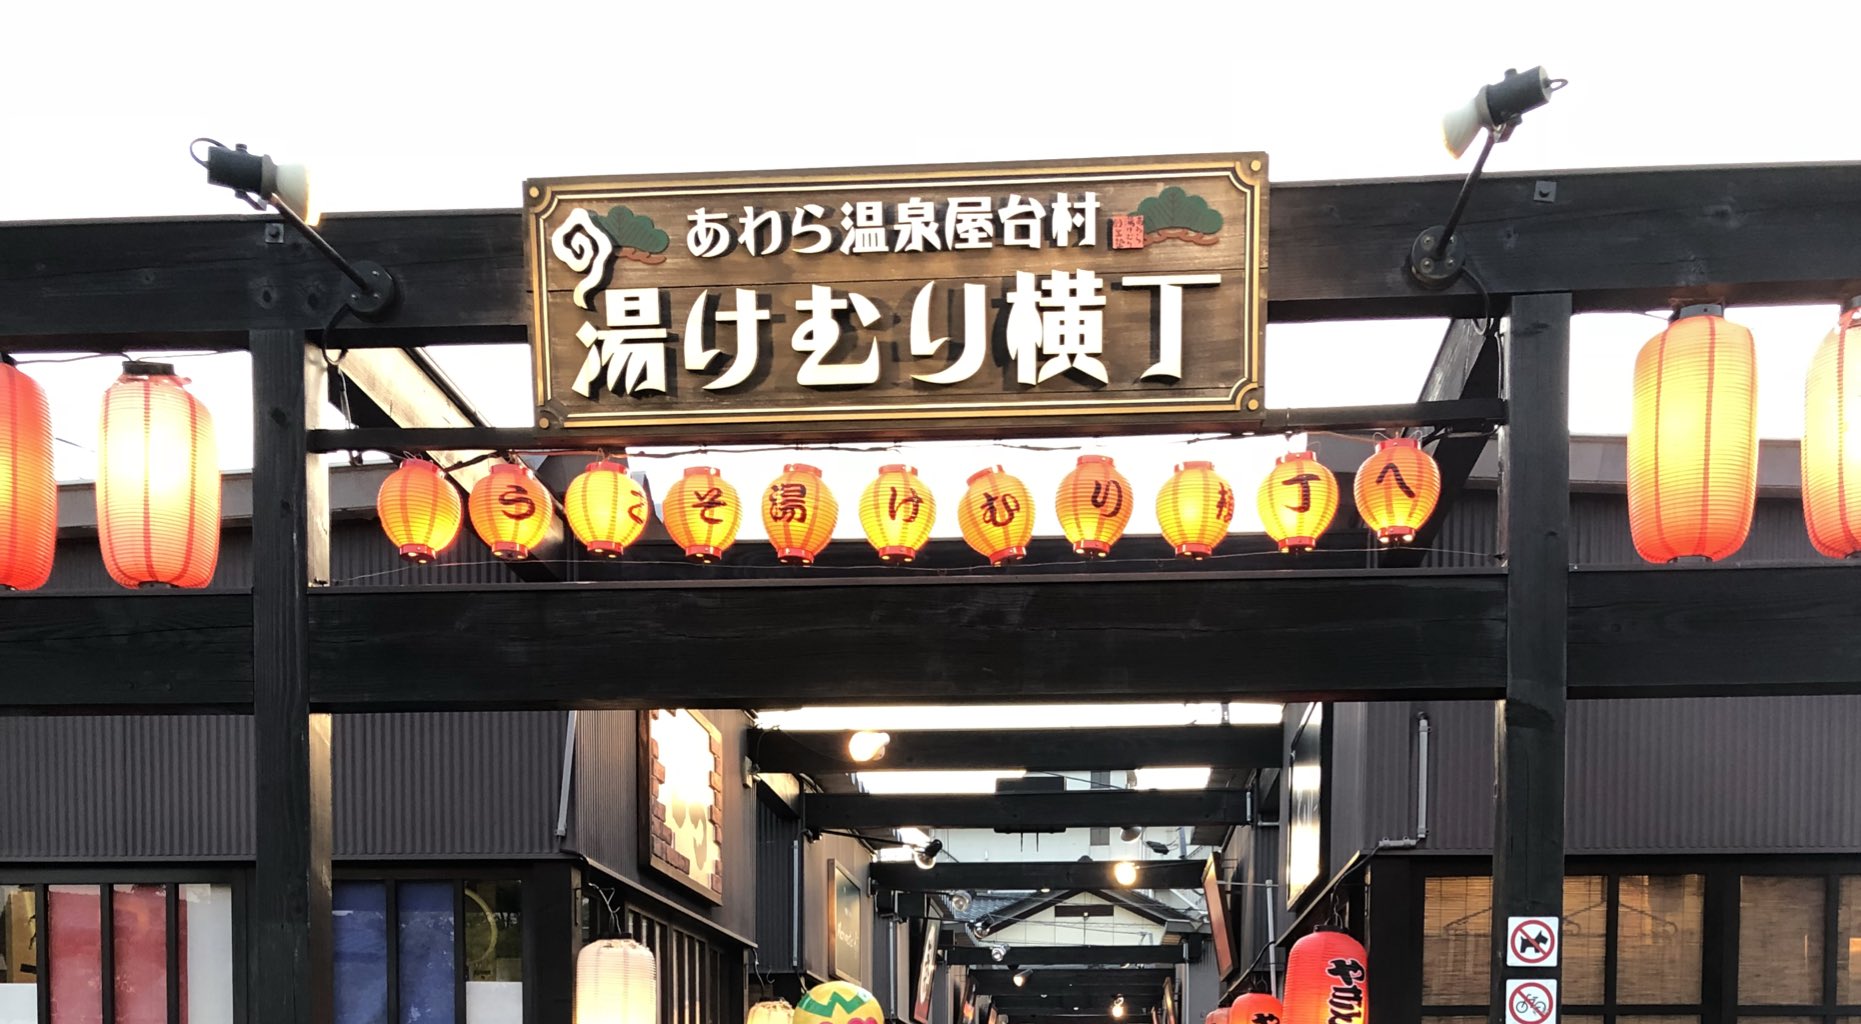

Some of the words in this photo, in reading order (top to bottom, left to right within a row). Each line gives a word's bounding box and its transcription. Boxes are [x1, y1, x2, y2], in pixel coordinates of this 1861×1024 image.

[686, 192, 1101, 258] あわら温泉屋台村
[571, 268, 1222, 398] 湯けむり横丁
[499, 484, 535, 520] う
[692, 488, 727, 525] そ
[768, 484, 807, 524] 湯
[888, 486, 923, 523] け
[980, 491, 1020, 528] む
[1091, 480, 1122, 518] り
[1282, 473, 1321, 513] 丁
[1375, 462, 1415, 499] へ
